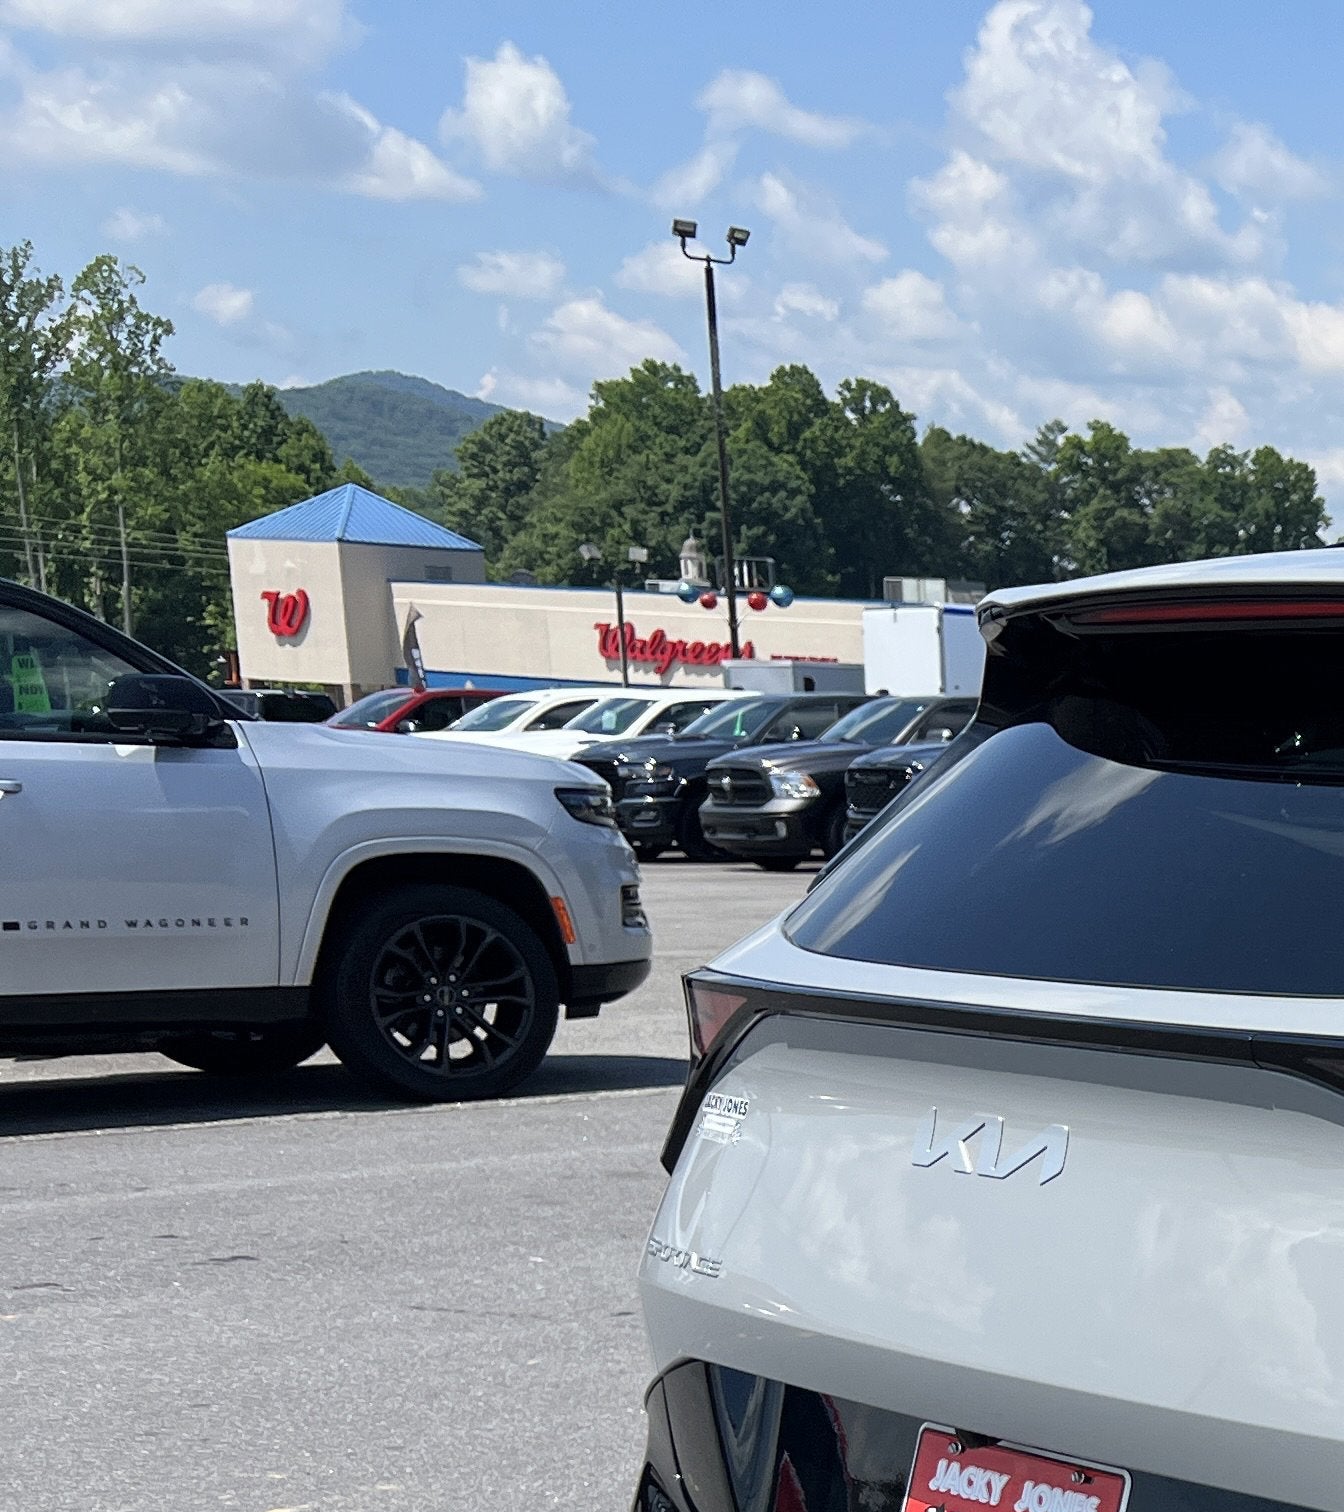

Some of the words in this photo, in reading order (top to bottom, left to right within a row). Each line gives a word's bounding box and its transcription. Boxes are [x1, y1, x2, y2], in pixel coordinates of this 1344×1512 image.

[260, 588, 309, 636] W
[27, 919, 107, 930] GRAND
[124, 916, 249, 928] WAGONEER
[722, 1097, 749, 1116] JONES
[928, 1458, 1011, 1506] JACKY
